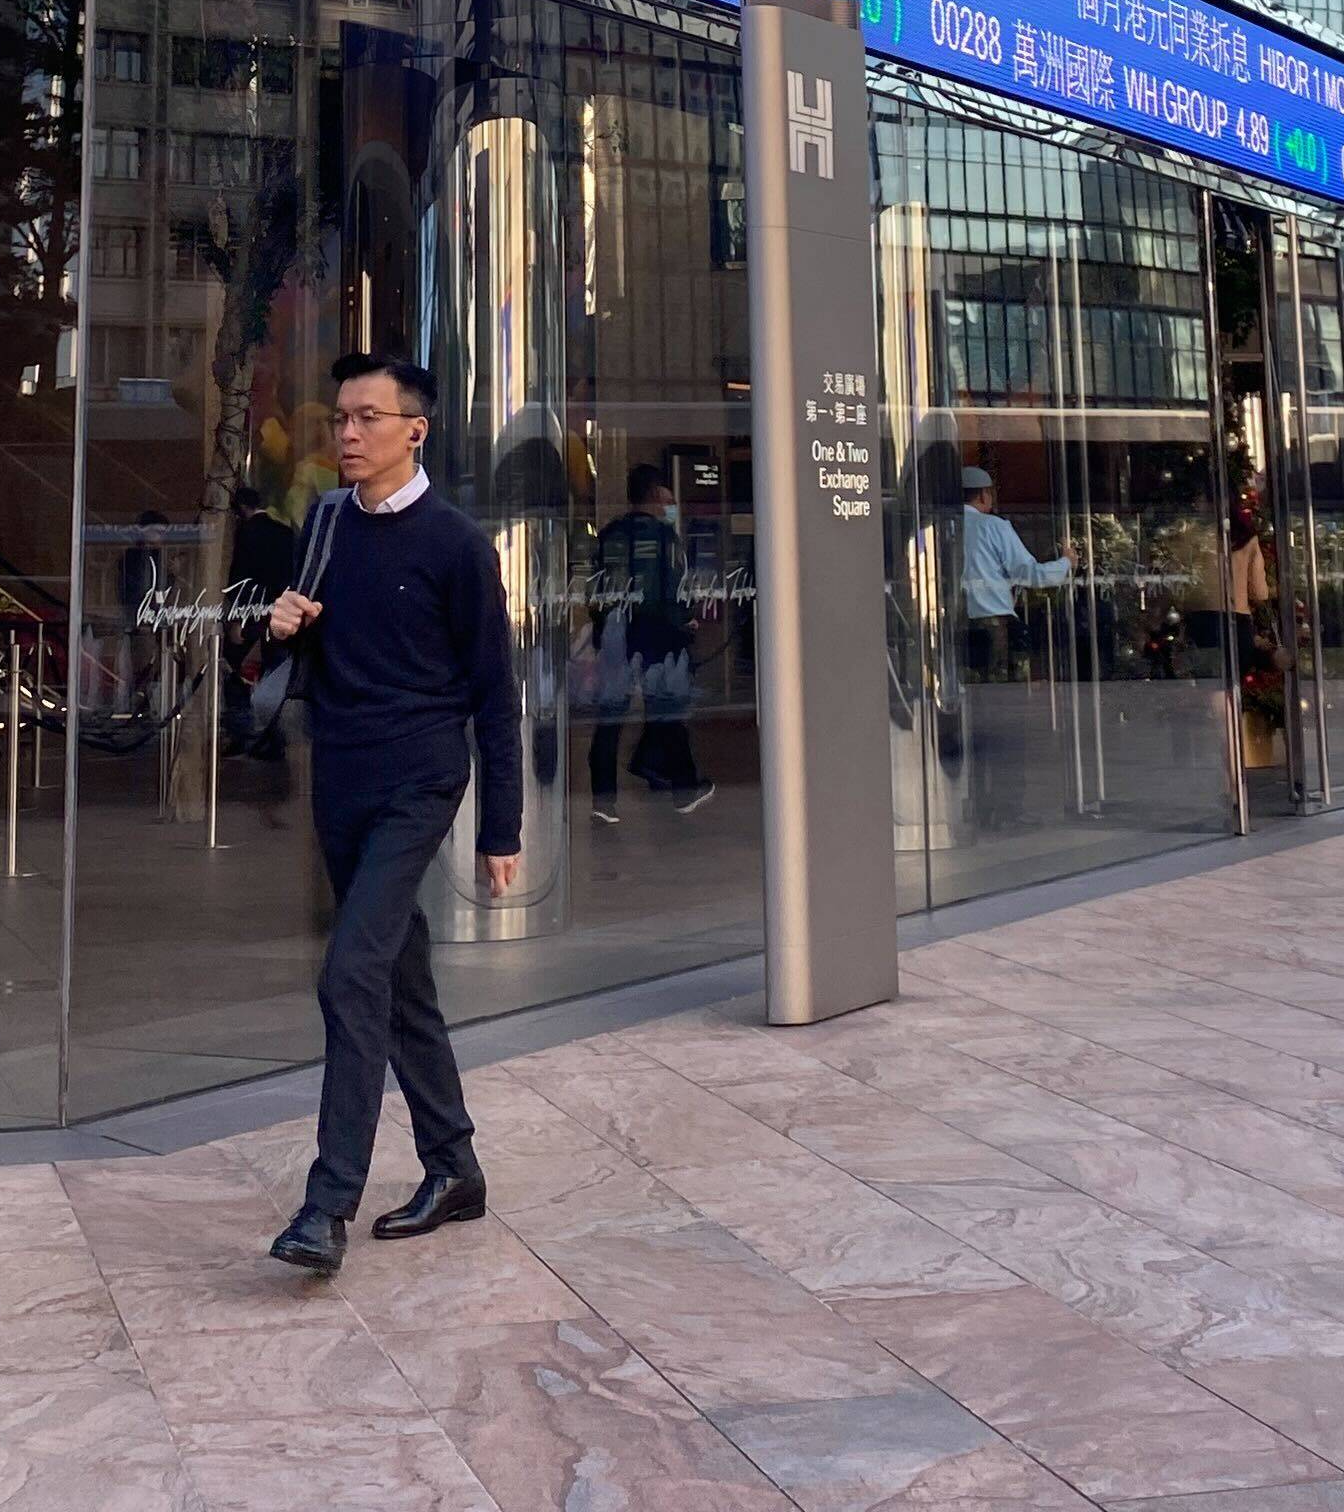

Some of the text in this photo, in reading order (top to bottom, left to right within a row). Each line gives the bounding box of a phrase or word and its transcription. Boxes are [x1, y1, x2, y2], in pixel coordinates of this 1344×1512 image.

[1011, 18, 1116, 111] 萬洲國際
[1123, 65, 1159, 118] WH
[1163, 79, 1228, 139] GROUP
[1236, 107, 1269, 156] 4.89
[1259, 43, 1310, 100] HIBOR
[1312, 65, 1322, 104] 1
[812, 440, 869, 463] One & Two
[819, 467, 870, 495] Exchange
[833, 495, 871, 520] Square
